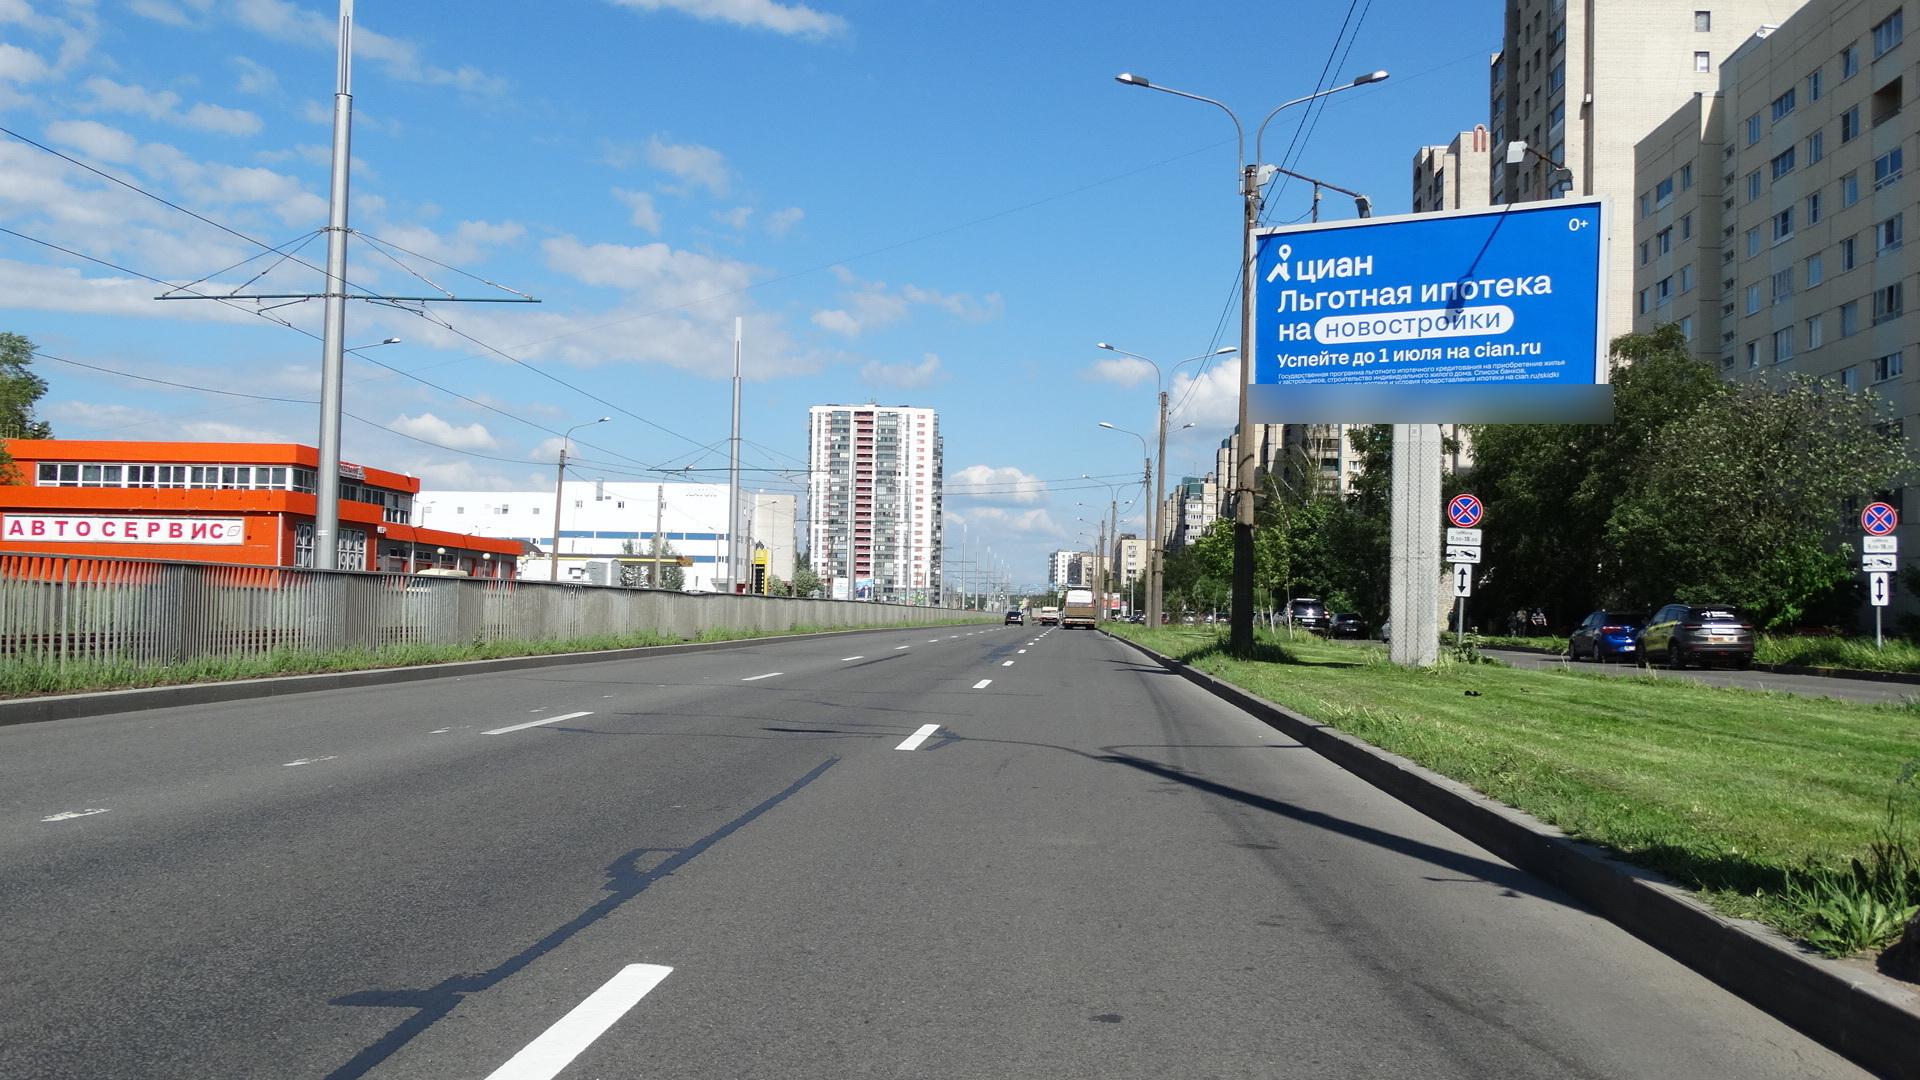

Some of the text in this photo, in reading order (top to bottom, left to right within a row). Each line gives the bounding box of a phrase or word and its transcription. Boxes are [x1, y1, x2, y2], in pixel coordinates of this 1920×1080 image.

[1568, 218, 1588, 231] 0+
[1297, 254, 1373, 284] циан
[1277, 274, 1552, 314] Льготная ипотека
[1279, 309, 1500, 342] на новостройки
[1277, 342, 1541, 368] Успейте до 1 июля на cian.ru
[1436, 364, 1482, 372] кредитования
[1492, 361, 1543, 369] приобретение
[9, 519, 223, 539] АВТОСЕРВИС
